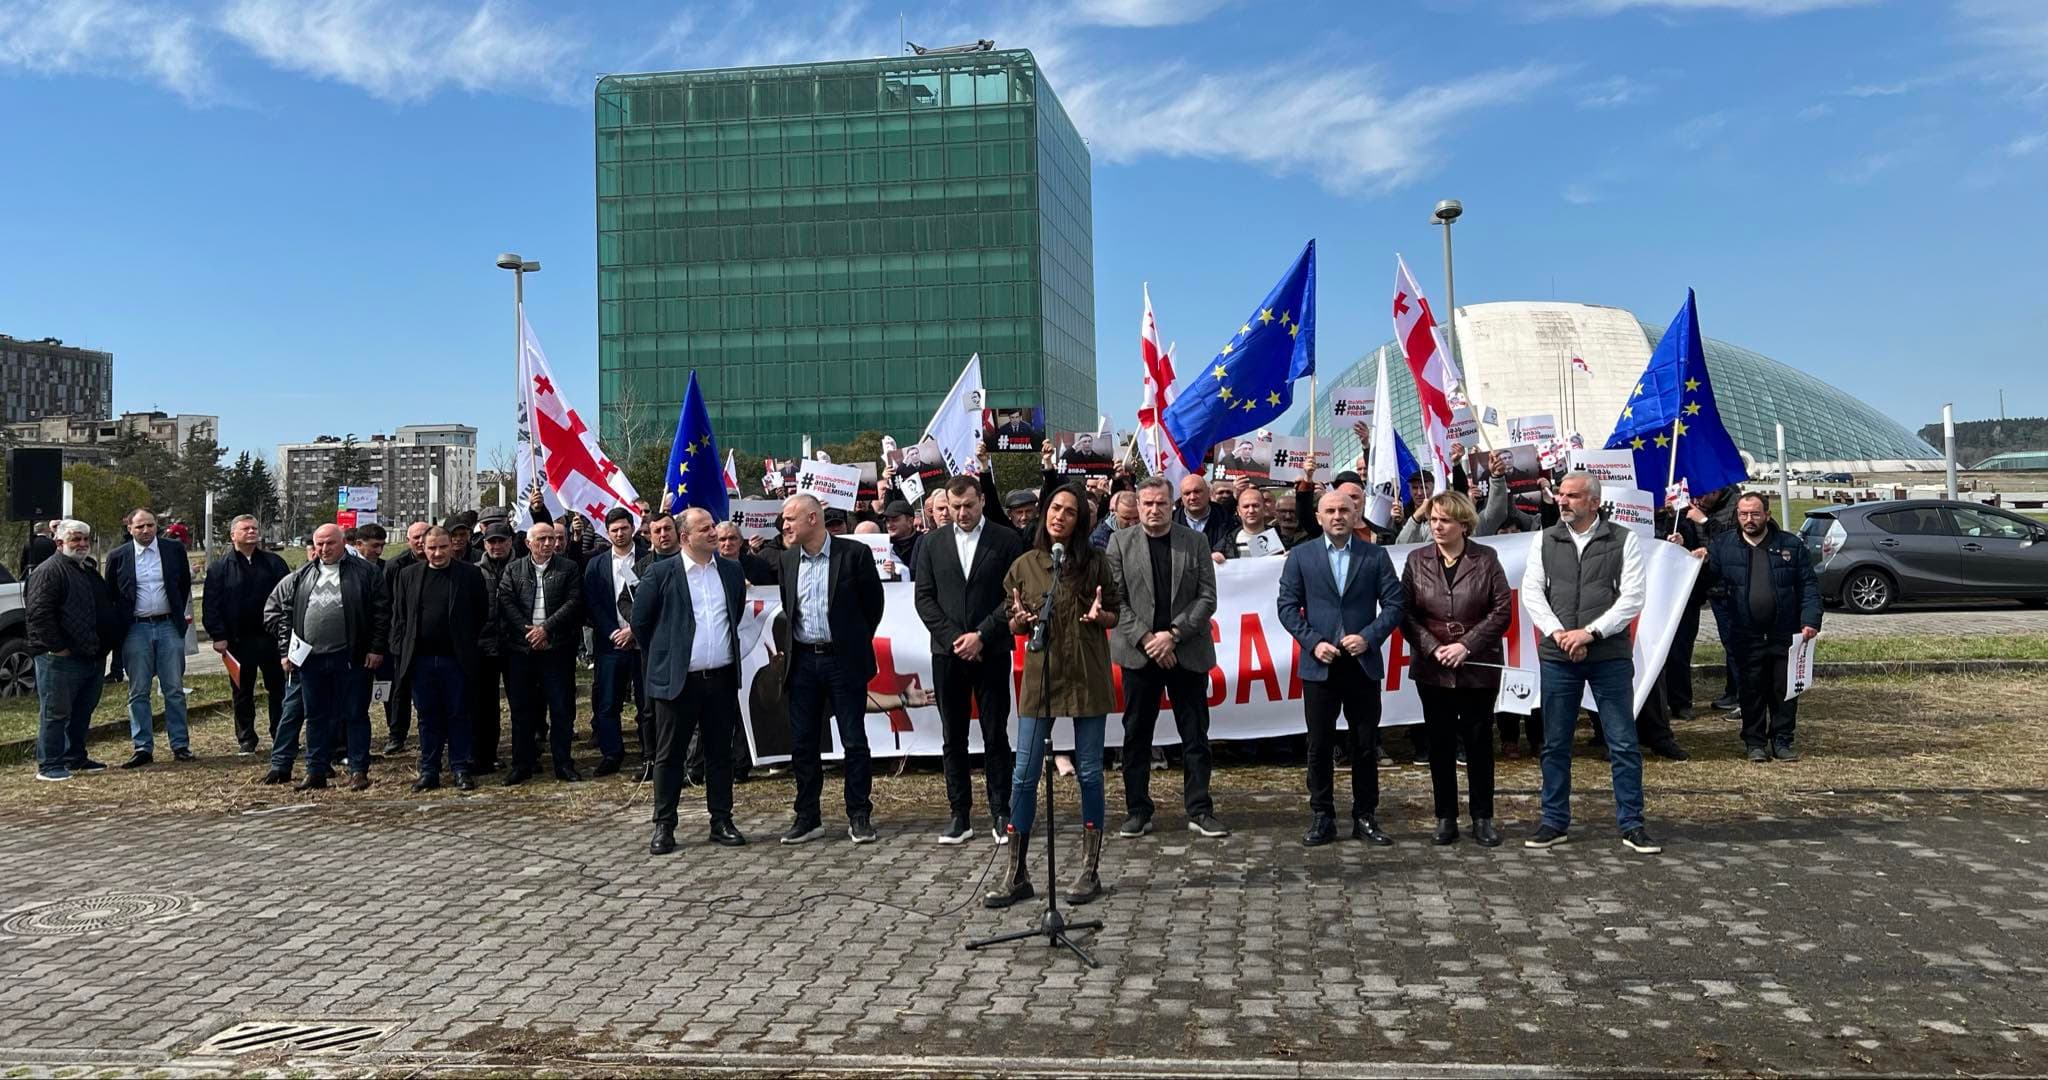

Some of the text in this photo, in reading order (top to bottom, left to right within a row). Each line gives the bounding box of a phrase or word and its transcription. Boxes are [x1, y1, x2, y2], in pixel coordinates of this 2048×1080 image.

[997, 434, 1009, 450] #
[1274, 449, 1288, 467] #
[801, 472, 815, 490] #
[813, 485, 854, 498] FREEMISHA
[731, 510, 744, 527] #
